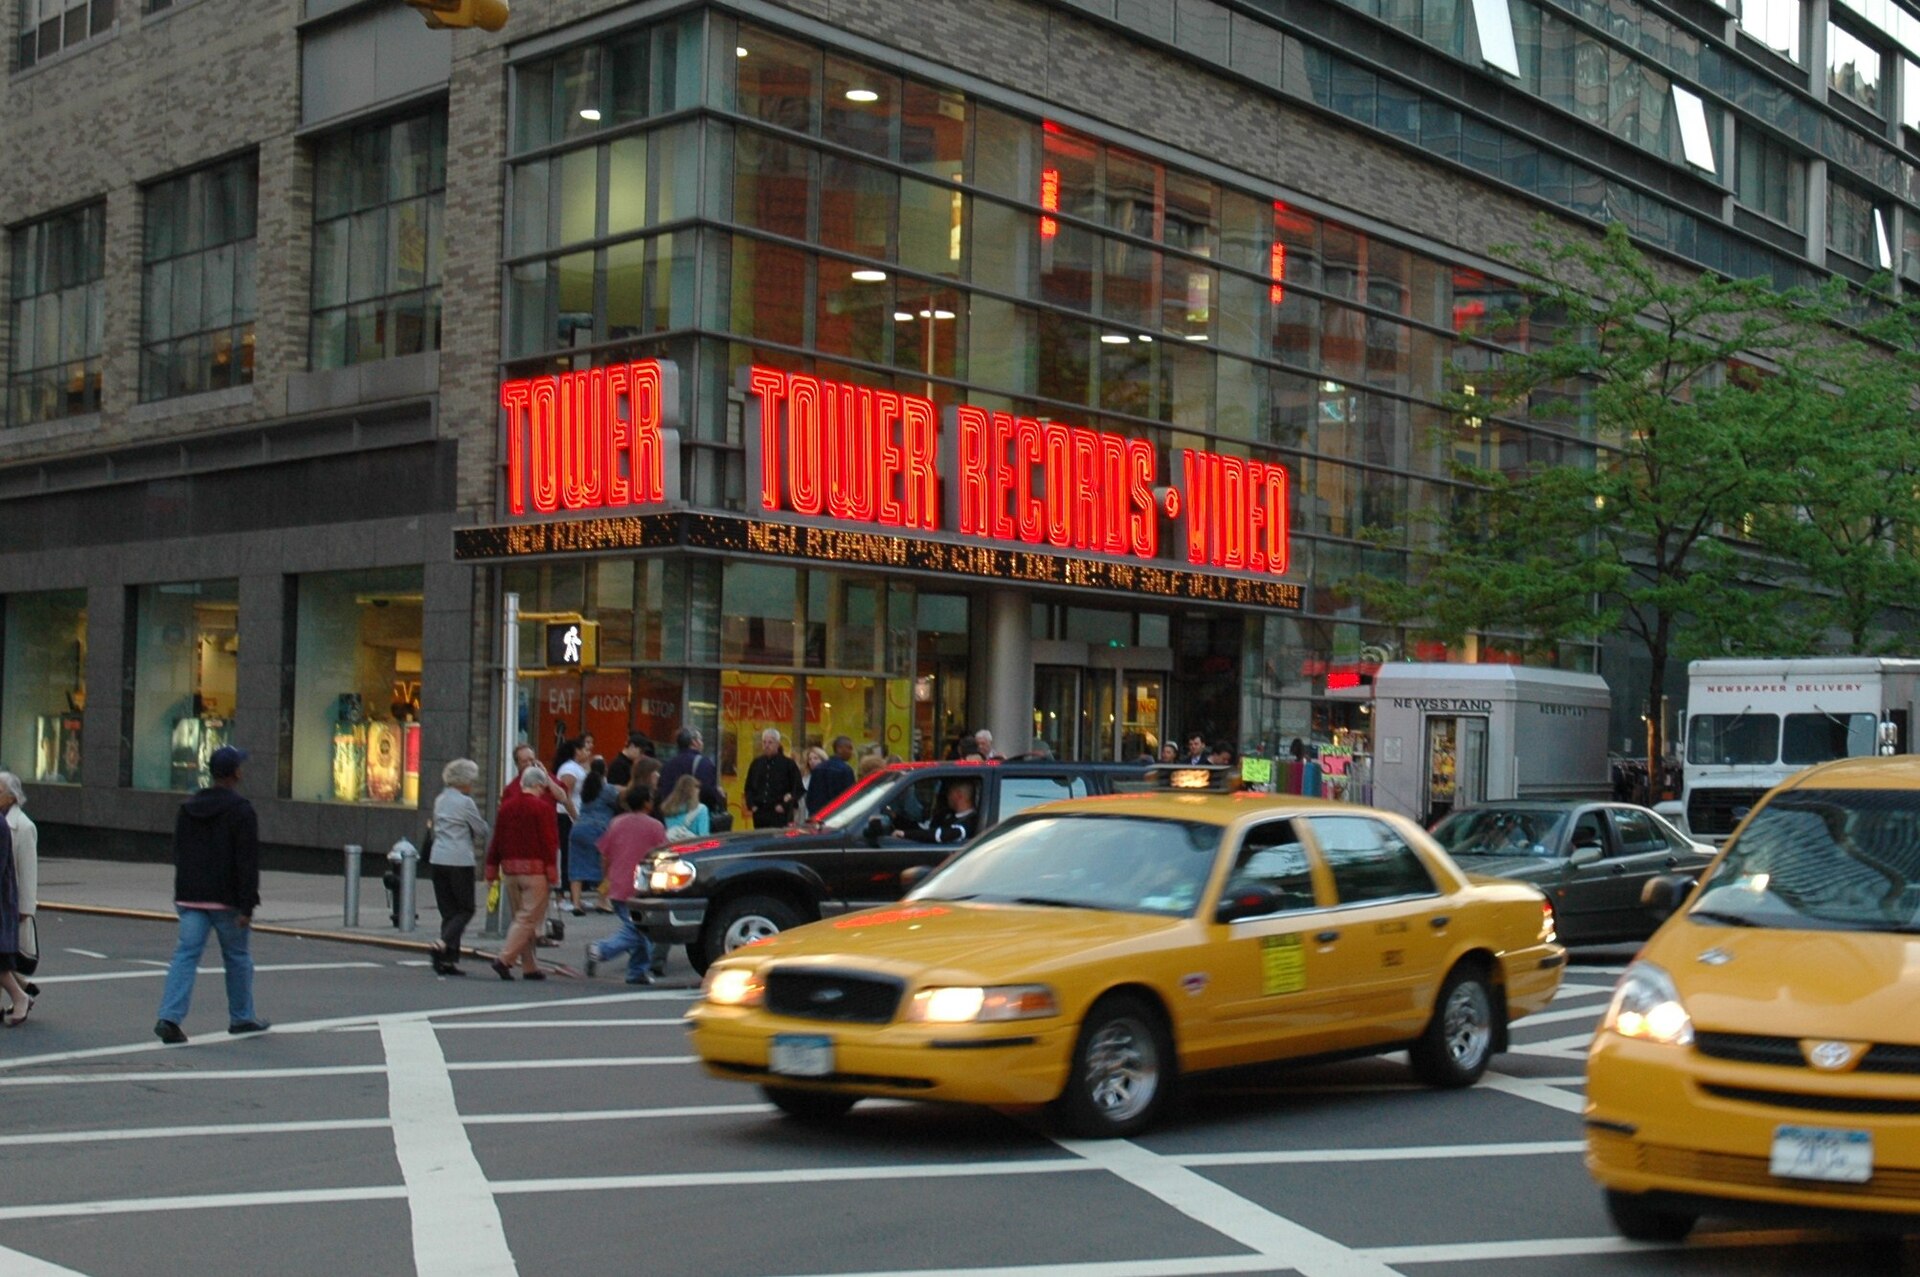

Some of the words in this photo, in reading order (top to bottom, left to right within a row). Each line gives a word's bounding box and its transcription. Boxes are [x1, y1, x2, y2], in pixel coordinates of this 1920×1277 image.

[503, 358, 665, 515] TOWER
[750, 364, 938, 532] TOWER
[957, 405, 1157, 559] RECORDS
[1183, 448, 1290, 575] VIDEO
[748, 520, 797, 555] NEW
[806, 527, 906, 567] RIHANNA
[1707, 685, 1788, 693] NEWSPAPER
[1796, 683, 1863, 692] DELIVERY
[549, 688, 575, 714] EAT
[600, 694, 627, 713] LOOK
[650, 700, 675, 718] STOP
[1393, 697, 1493, 711] NEWSSTAND
